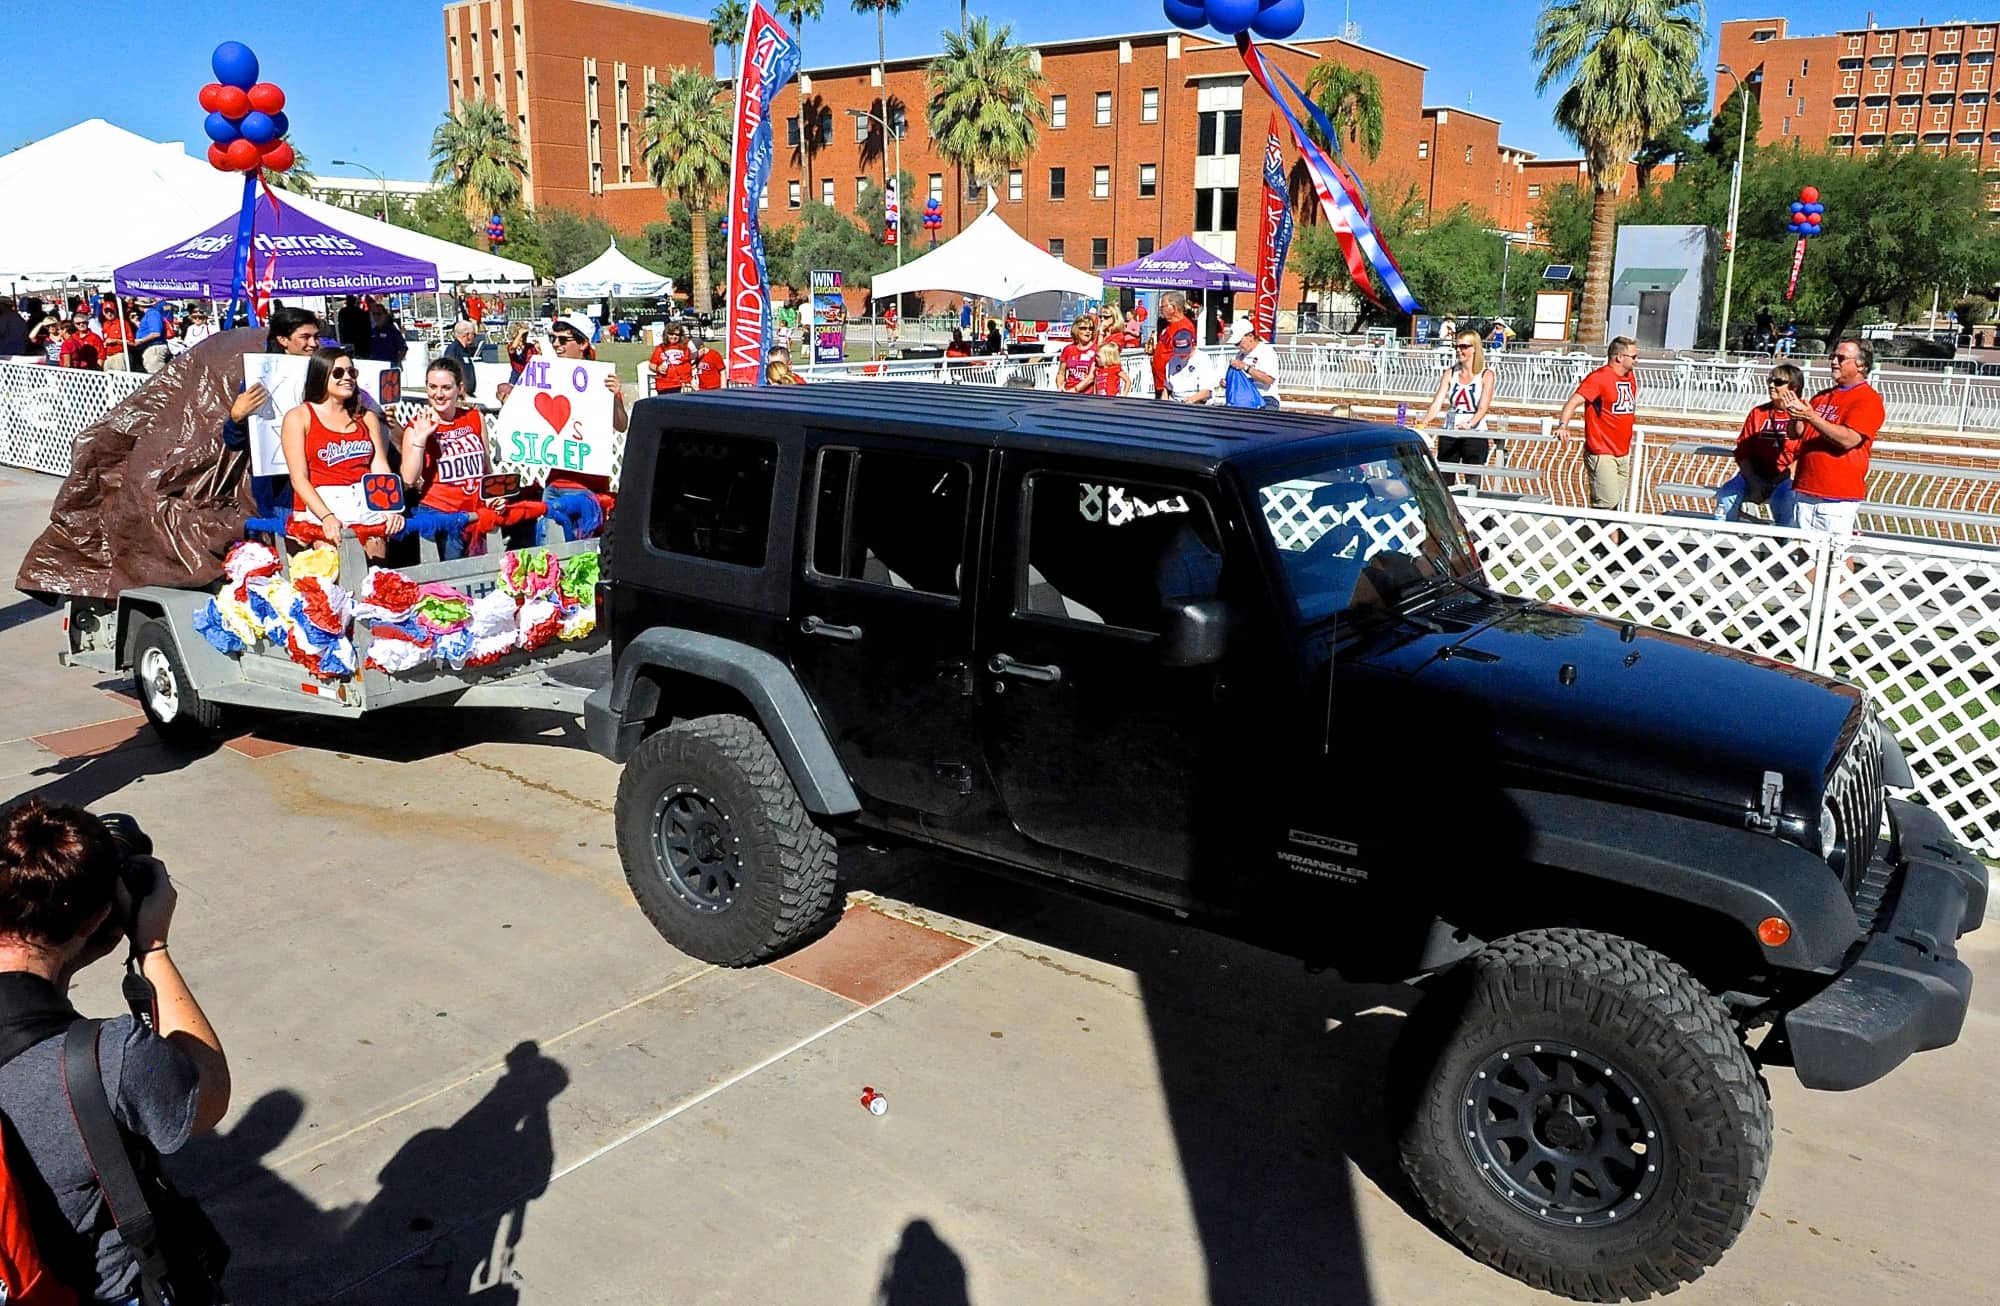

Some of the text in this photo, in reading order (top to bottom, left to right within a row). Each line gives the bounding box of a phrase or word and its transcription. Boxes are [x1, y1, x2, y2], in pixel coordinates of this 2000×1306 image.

[254, 234, 358, 251] Harrah's
[814, 273, 840, 287] WIN A
[517, 361, 588, 393] HI O
[1450, 382, 1478, 415] A
[510, 431, 591, 471] SIG EP
[1277, 851, 1368, 879] WRANGLER
[1290, 864, 1357, 883] UNLIMITED
